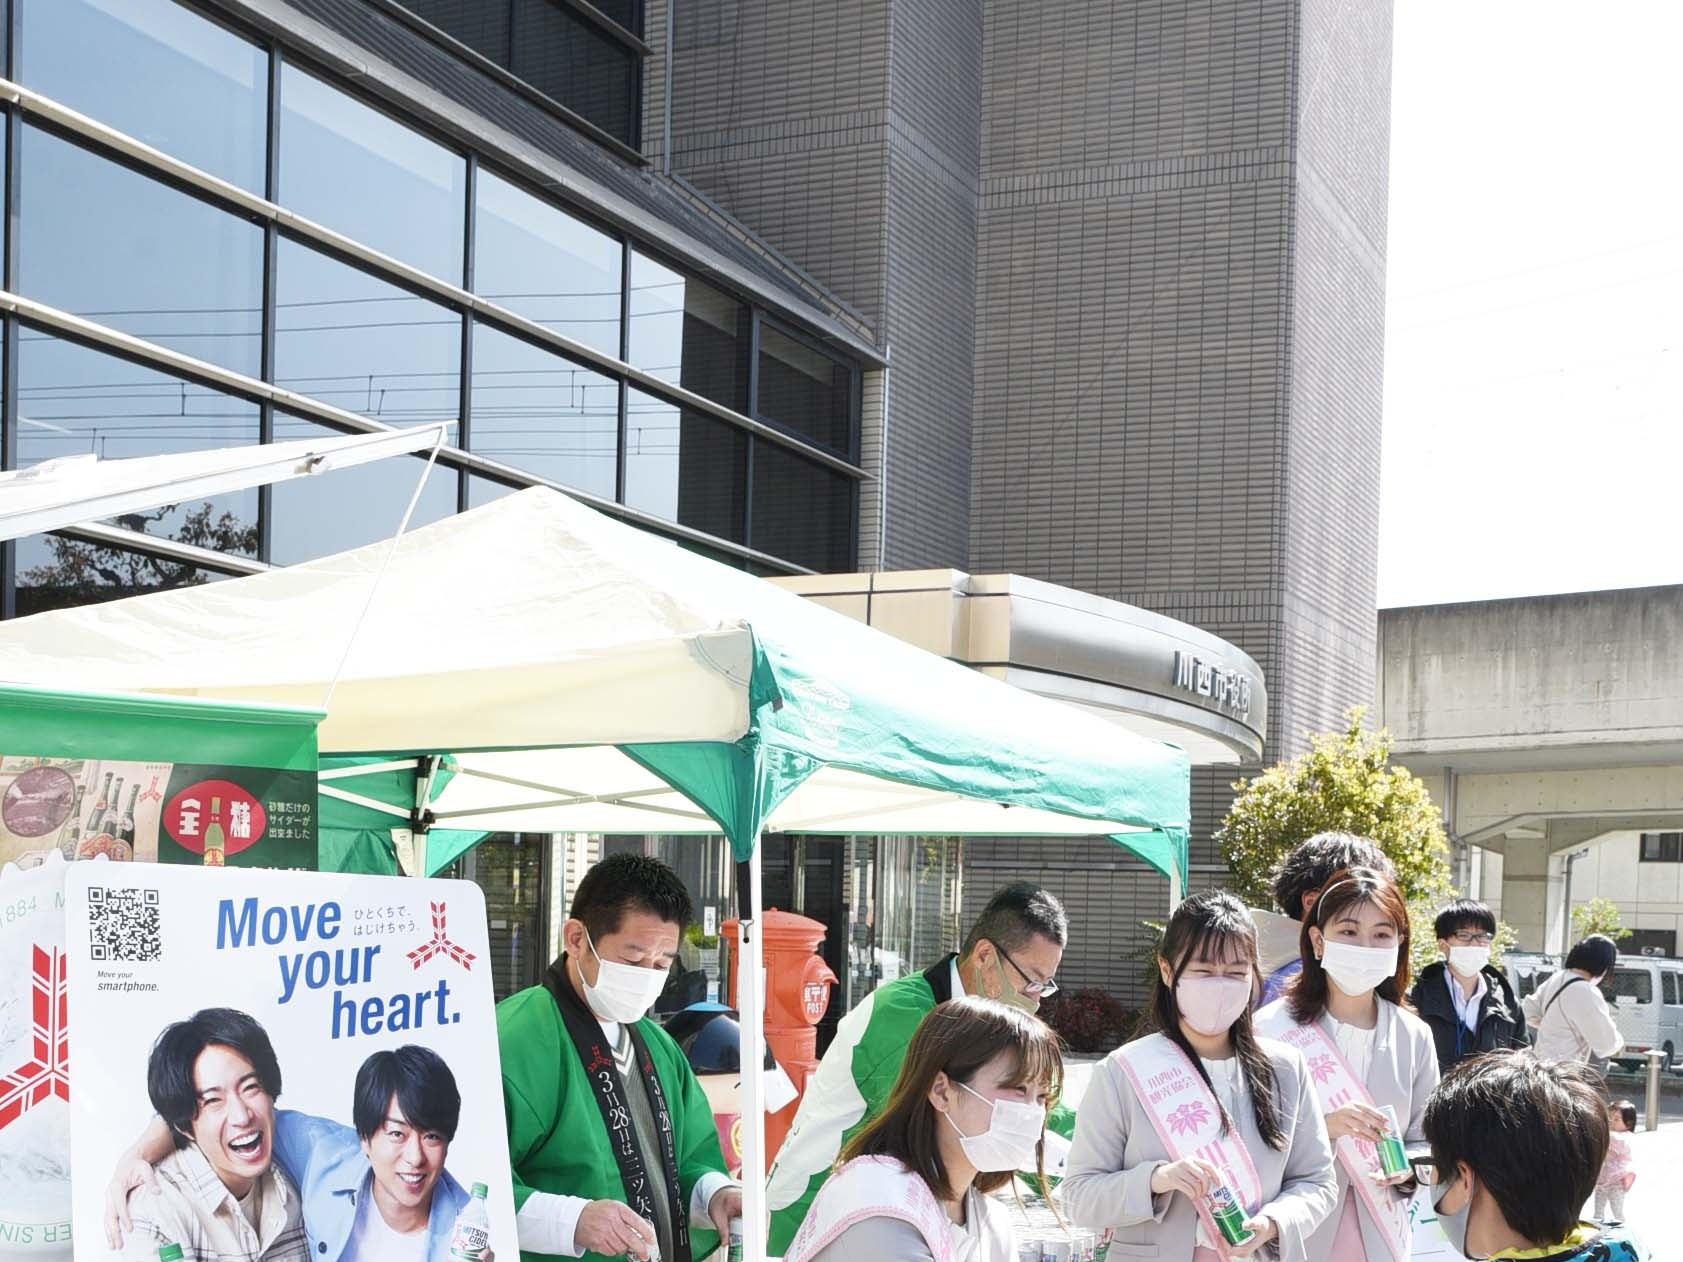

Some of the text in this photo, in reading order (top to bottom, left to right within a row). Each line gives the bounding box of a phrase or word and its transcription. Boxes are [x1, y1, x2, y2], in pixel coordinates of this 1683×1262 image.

[217, 898, 341, 949] Move
[97, 970, 133, 980] Move your
[97, 980, 160, 993] smartphone.
[278, 944, 381, 1004] your
[332, 979, 461, 1039] heart.
[807, 1001, 822, 1014] POST
